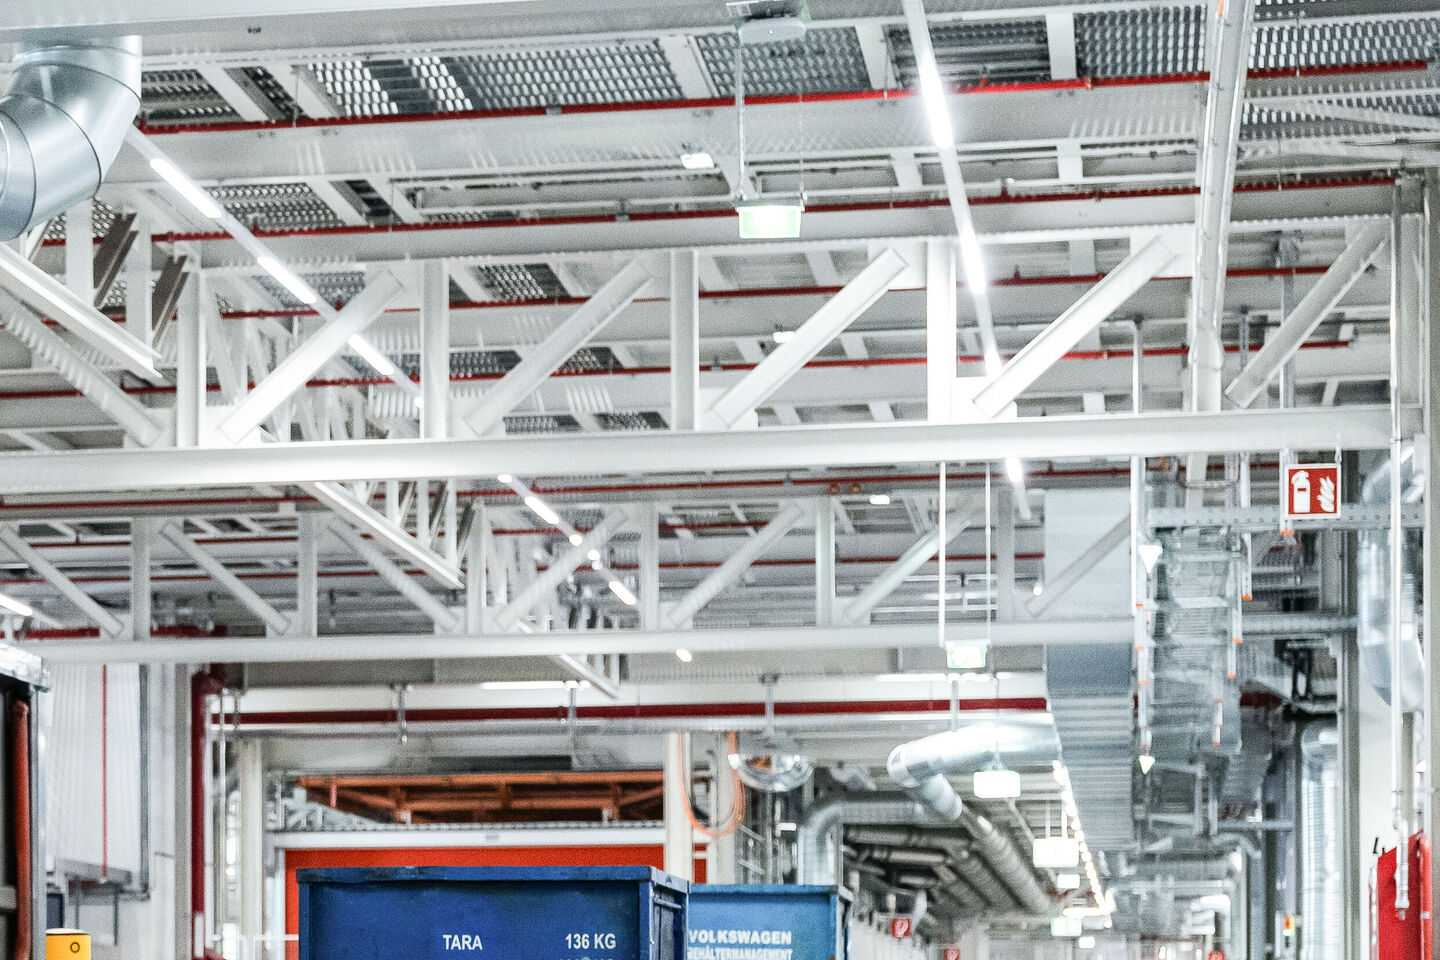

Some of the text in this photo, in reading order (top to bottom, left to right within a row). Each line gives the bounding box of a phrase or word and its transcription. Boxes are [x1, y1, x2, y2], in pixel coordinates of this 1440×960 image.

[443, 933, 616, 950] TARA 136 KG
[688, 929, 792, 945] VOLKSWAGEN
